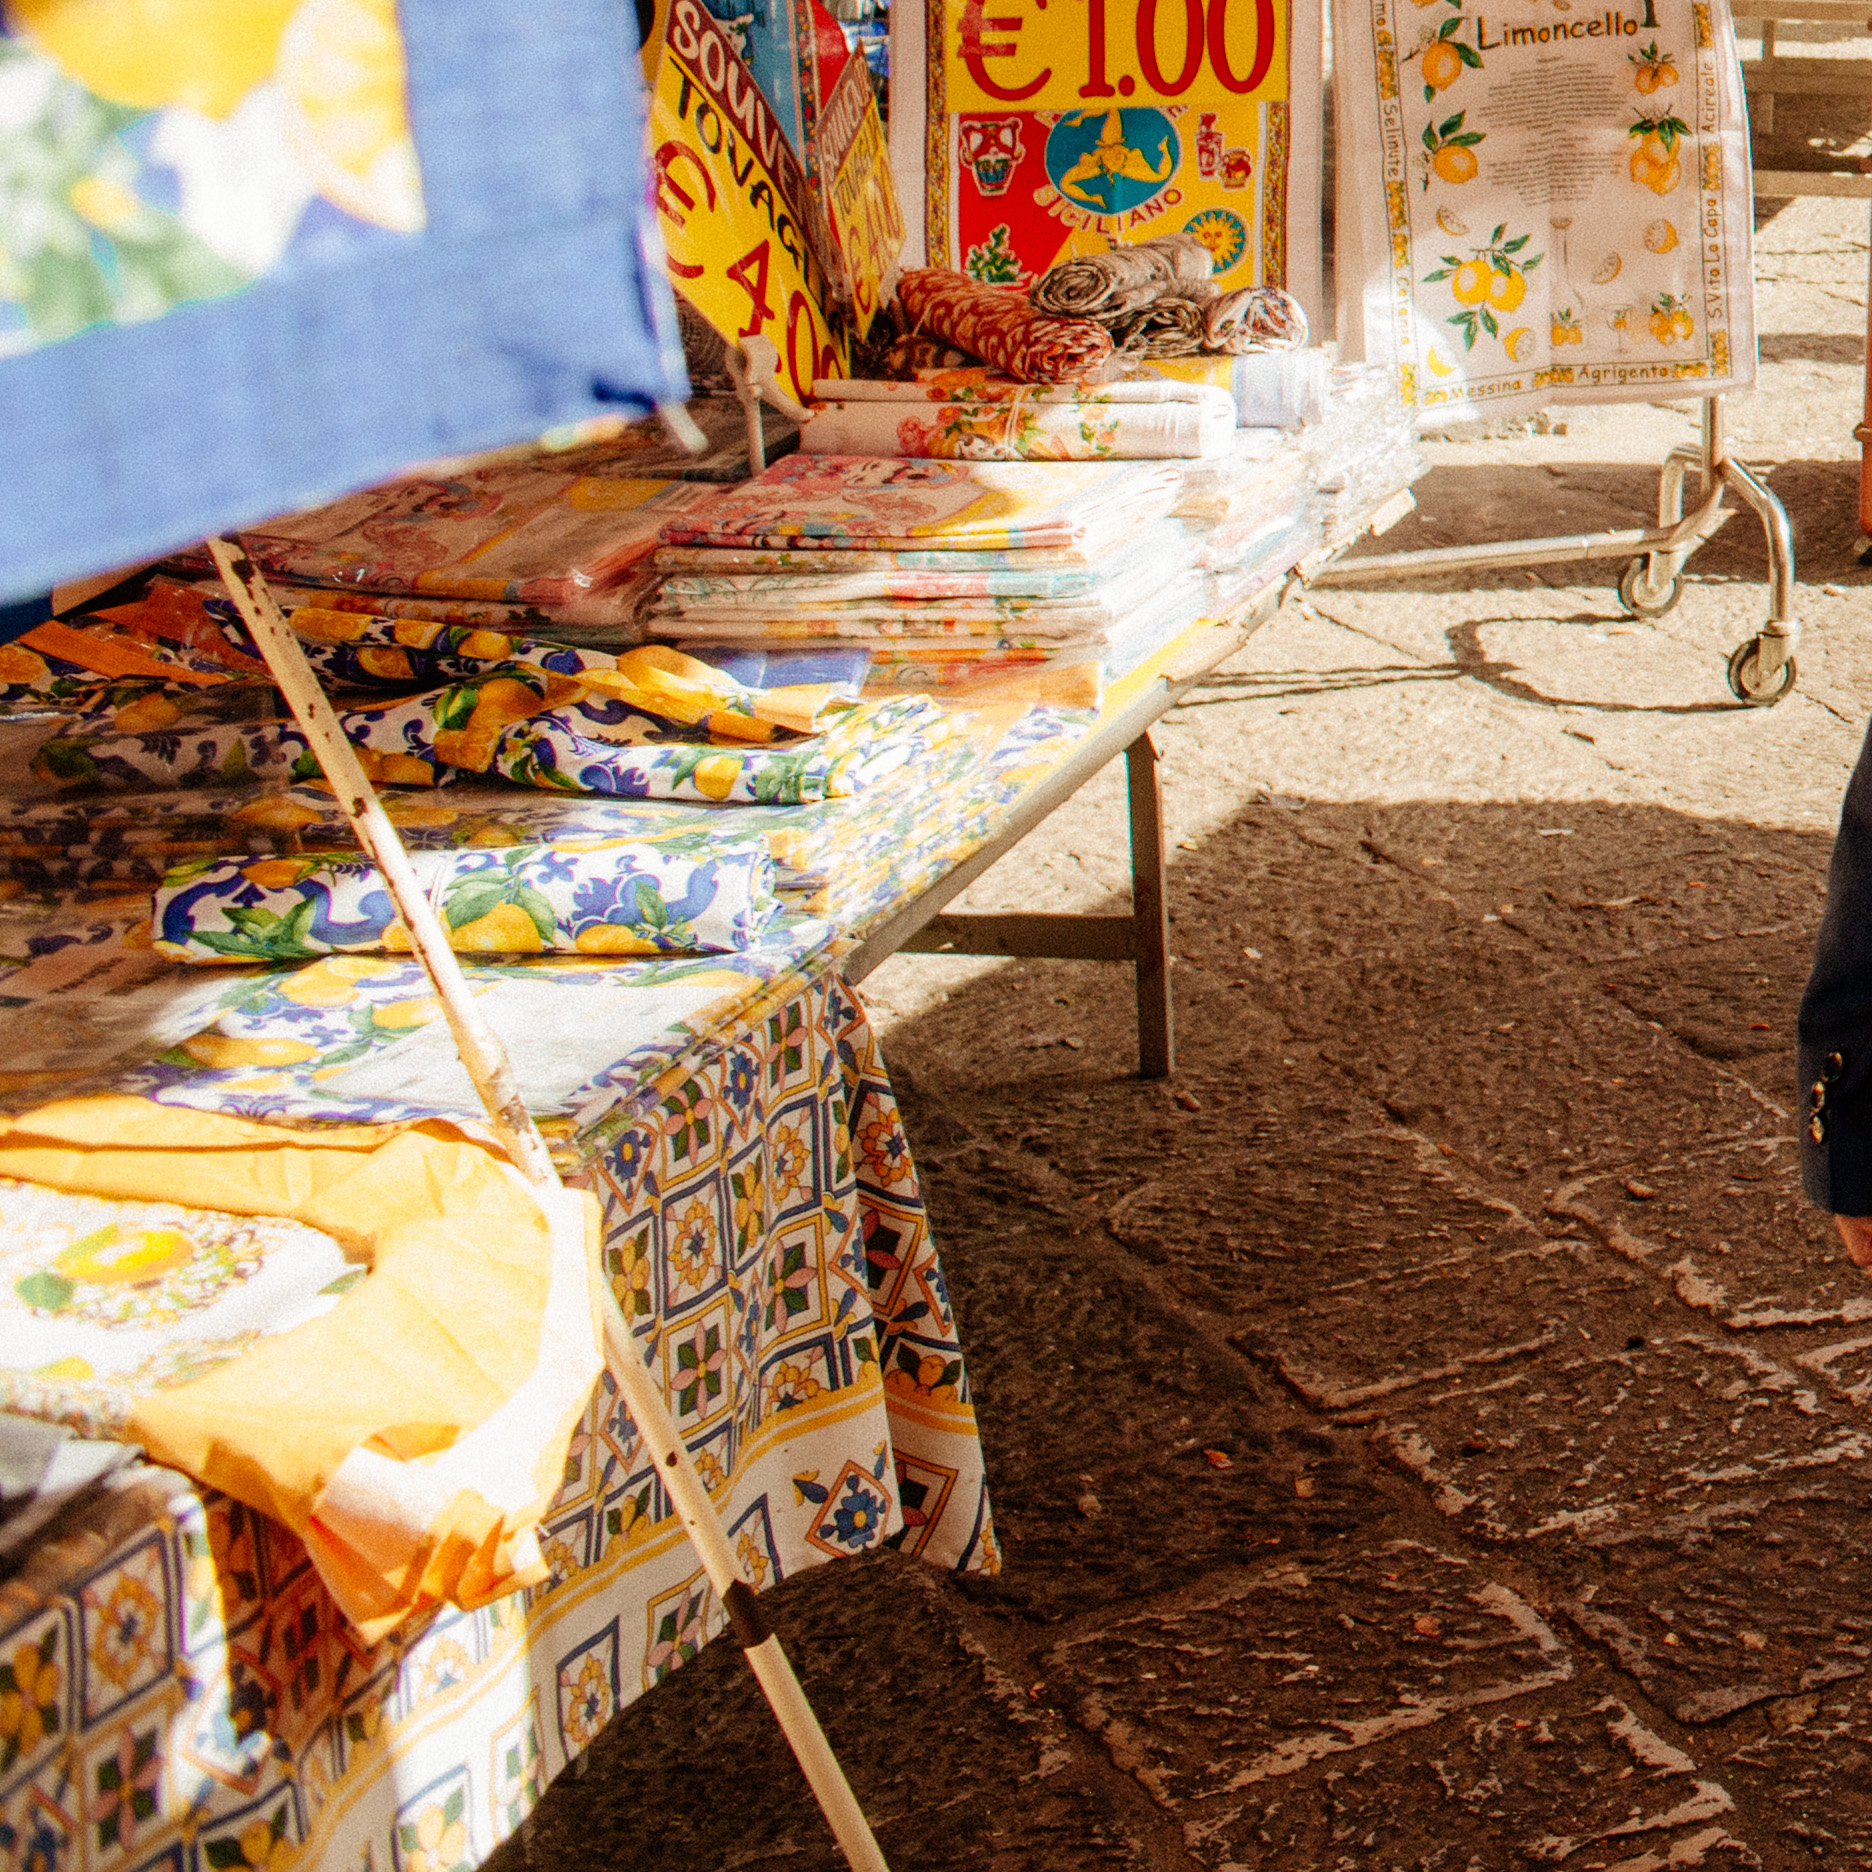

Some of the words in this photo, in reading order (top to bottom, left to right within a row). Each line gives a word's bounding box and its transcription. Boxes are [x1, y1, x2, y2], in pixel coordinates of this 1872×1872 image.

[1476, 11, 1639, 51] Limoncello
[1701, 60, 1715, 135] Acireale
[1033, 186, 1185, 237] SICILIANO
[1451, 378, 1523, 401] Messina
[1577, 365, 1668, 384] Agrigento
